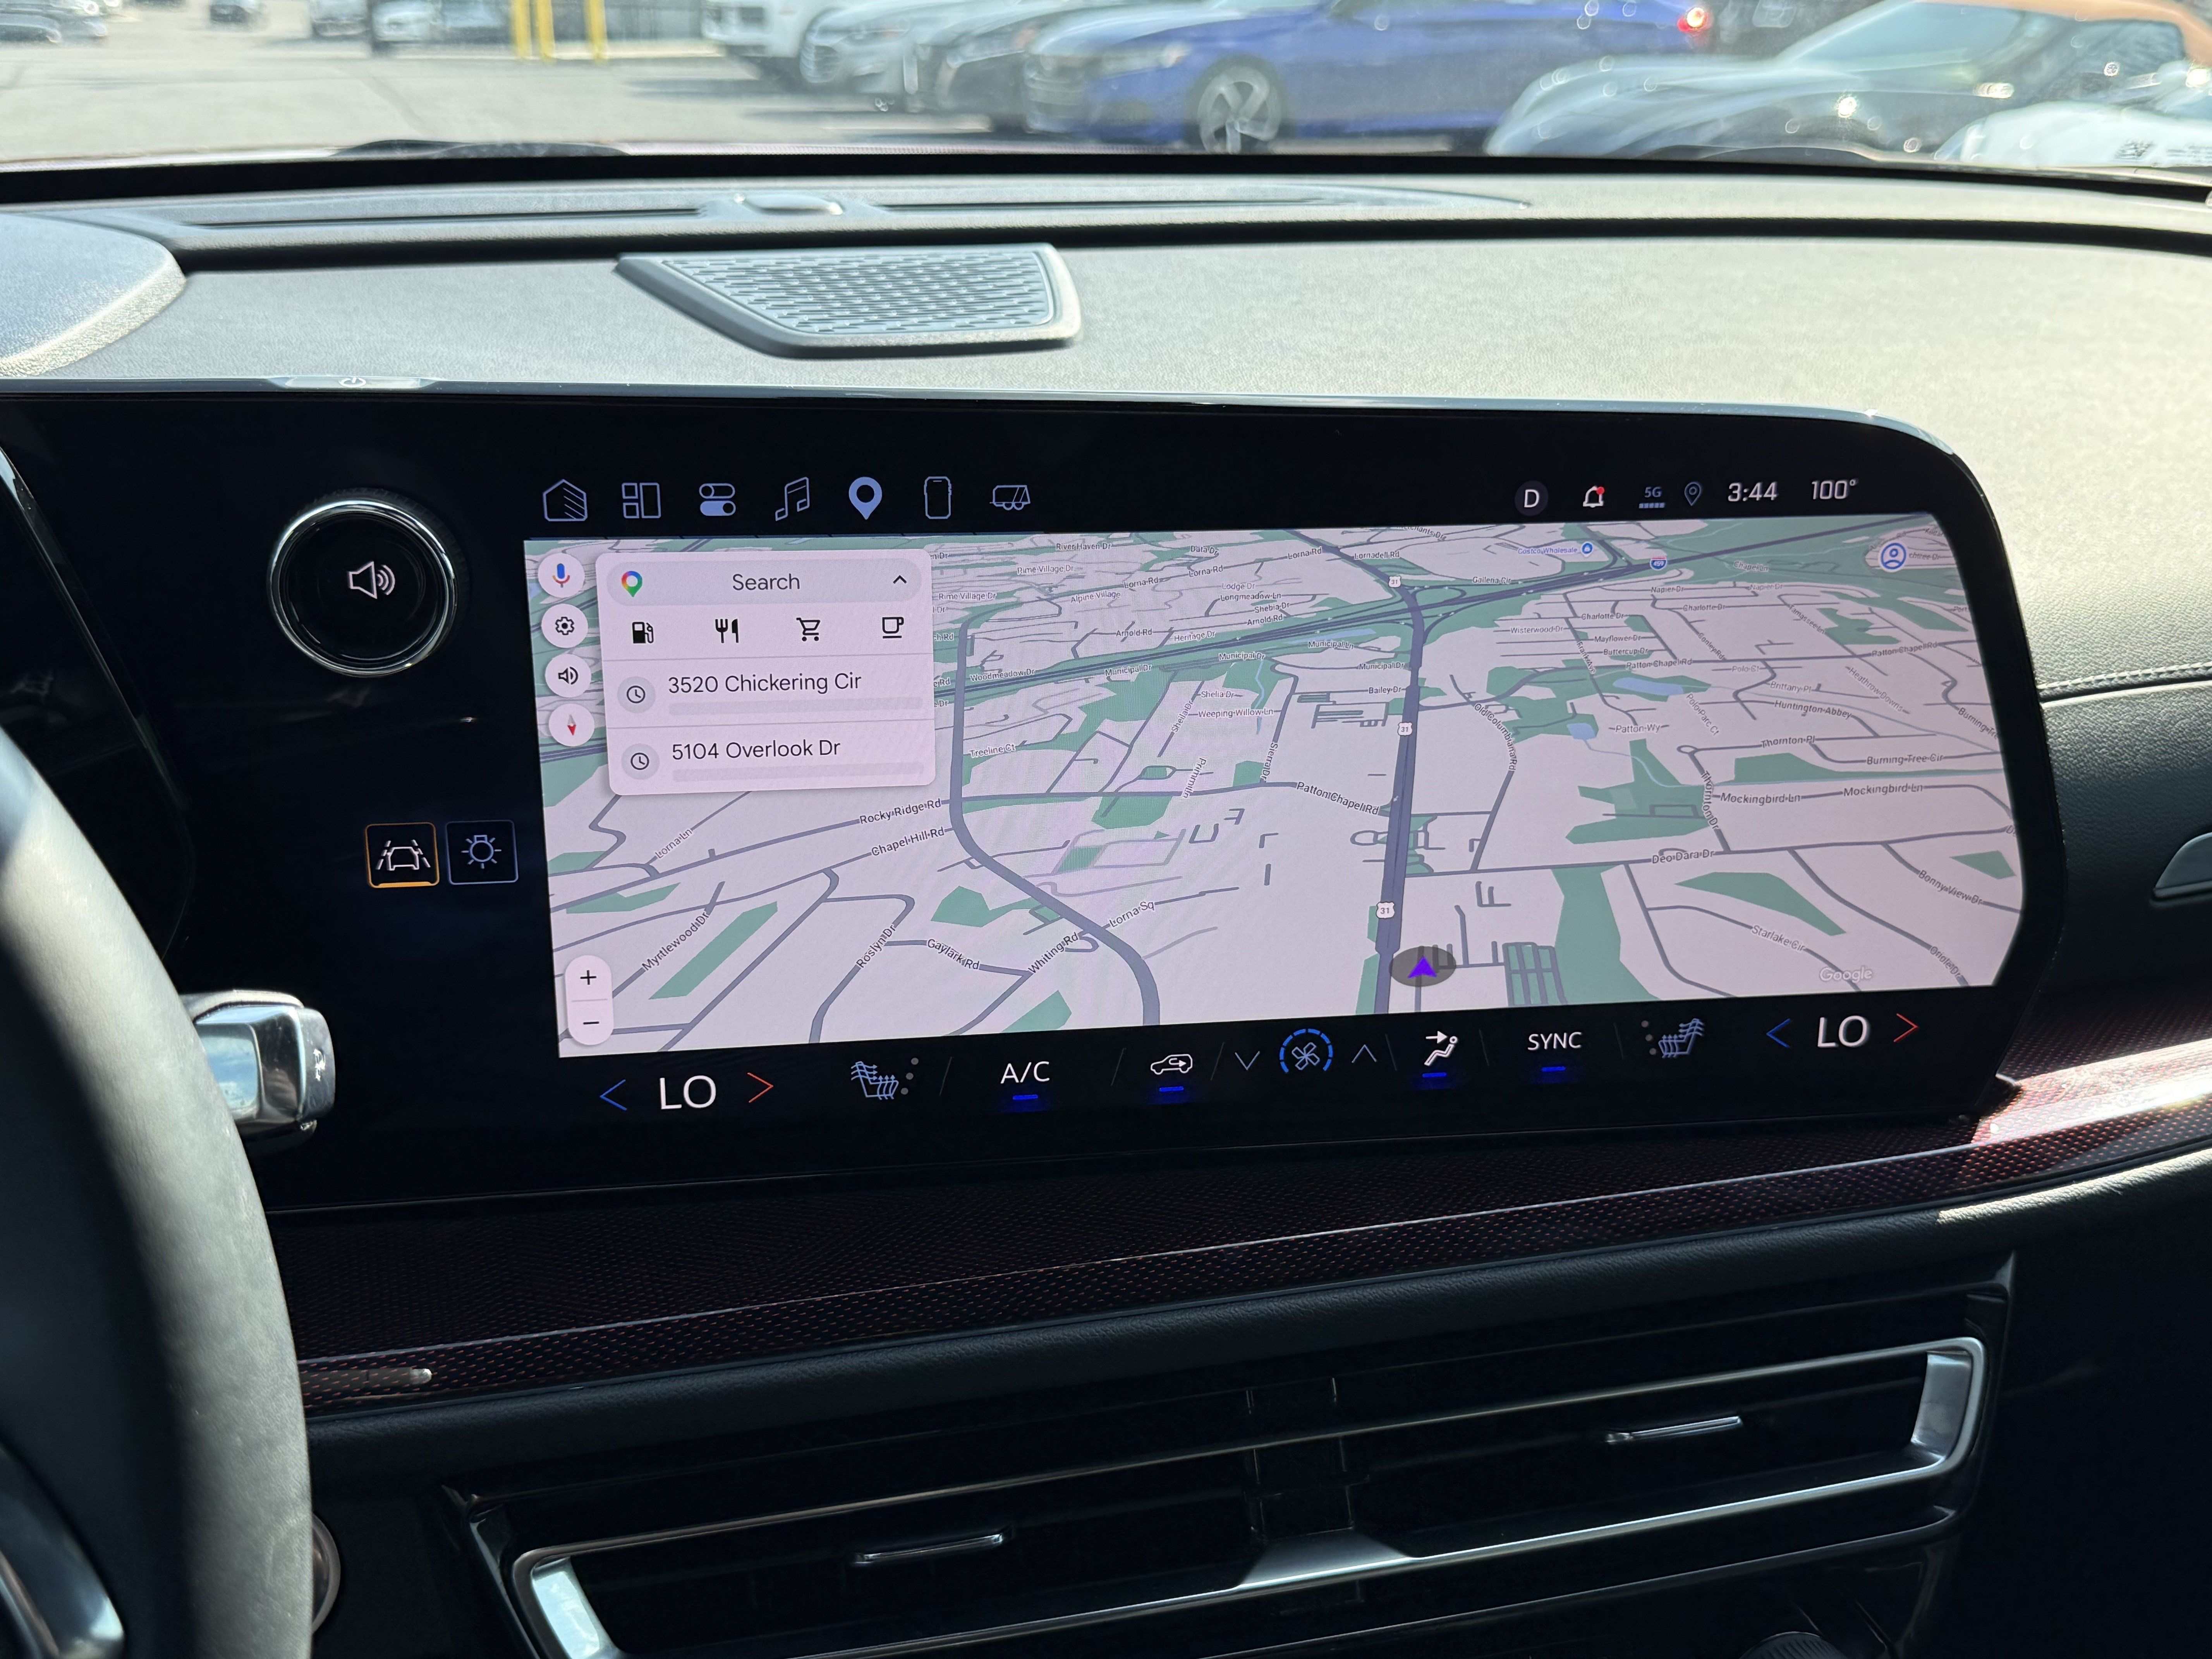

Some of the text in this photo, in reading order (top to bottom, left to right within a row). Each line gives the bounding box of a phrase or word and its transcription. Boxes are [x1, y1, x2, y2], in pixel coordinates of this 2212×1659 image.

[1524, 489, 1540, 508] D
[1644, 486, 1662, 498] 5G
[1728, 482, 1778, 502] 3:44
[1812, 479, 1857, 500] 100°
[1288, 550, 1310, 559] Lorna
[1017, 566, 1036, 575] Rime
[1037, 565, 1064, 574] Village
[1189, 568, 1210, 577] Lorna
[732, 574, 801, 592] Search
[1124, 579, 1145, 588] Lorna
[960, 592, 985, 601] Village
[1071, 592, 1121, 603] Alpine Village
[1220, 592, 1269, 602] Longmeadow
[1247, 617, 1271, 625] Arnold
[1174, 632, 1205, 641] Heritage
[1595, 635, 1630, 643] Mayflower
[1603, 648, 1637, 656] Buttercup
[1106, 666, 1142, 676] Municipal
[1359, 662, 1394, 670] Municipal
[1653, 659, 1680, 669] Chapel
[668, 672, 862, 694] 3520 Chickering Cir
[971, 670, 1024, 682] Woodmeadow
[1770, 681, 1800, 692] Brittany
[1171, 700, 1194, 733] Sheila Dr
[1686, 694, 1719, 735] Polo Parc Ct
[1774, 700, 1852, 720] Huntington Abbey
[1475, 704, 1517, 770] Old Columbiana Rd
[1647, 725, 1660, 733] Wy
[672, 740, 841, 760] 5104 Overlook Dr
[970, 746, 1003, 758] Treeline
[1761, 737, 1803, 749] Thornton
[1261, 742, 1278, 780] Sierra Dr
[1867, 754, 1944, 766] Burning Tree Cir
[1297, 781, 1379, 815] Patton Chapel Rd
[1720, 793, 1801, 805] Mockingbird Ln
[1843, 783, 1923, 797] Mockingbird Ln
[1701, 771, 1719, 829] Thornton Dr
[860, 799, 941, 825] Rocky Ridge Rd
[656, 828, 692, 859] Lorna Ln
[871, 826, 945, 857] Chapel Hill Rd
[1652, 849, 1714, 864] Deo Dara Dr
[1919, 870, 1983, 905] Bonny View Dr
[1109, 901, 1155, 927] Lorna Sq
[641, 912, 709, 971] Myrtlewood Dr
[1752, 925, 1790, 946] Starlake
[856, 924, 896, 968] Roslyn Dr
[927, 938, 979, 970] Gaylark Rd
[1028, 932, 1079, 974] Whiting Rd
[1820, 965, 1872, 982] Google
[1817, 1015, 1869, 1048] LO
[1528, 1031, 1582, 1051] SYNC
[1001, 1061, 1049, 1083] A/C
[660, 1075, 716, 1111] LO
